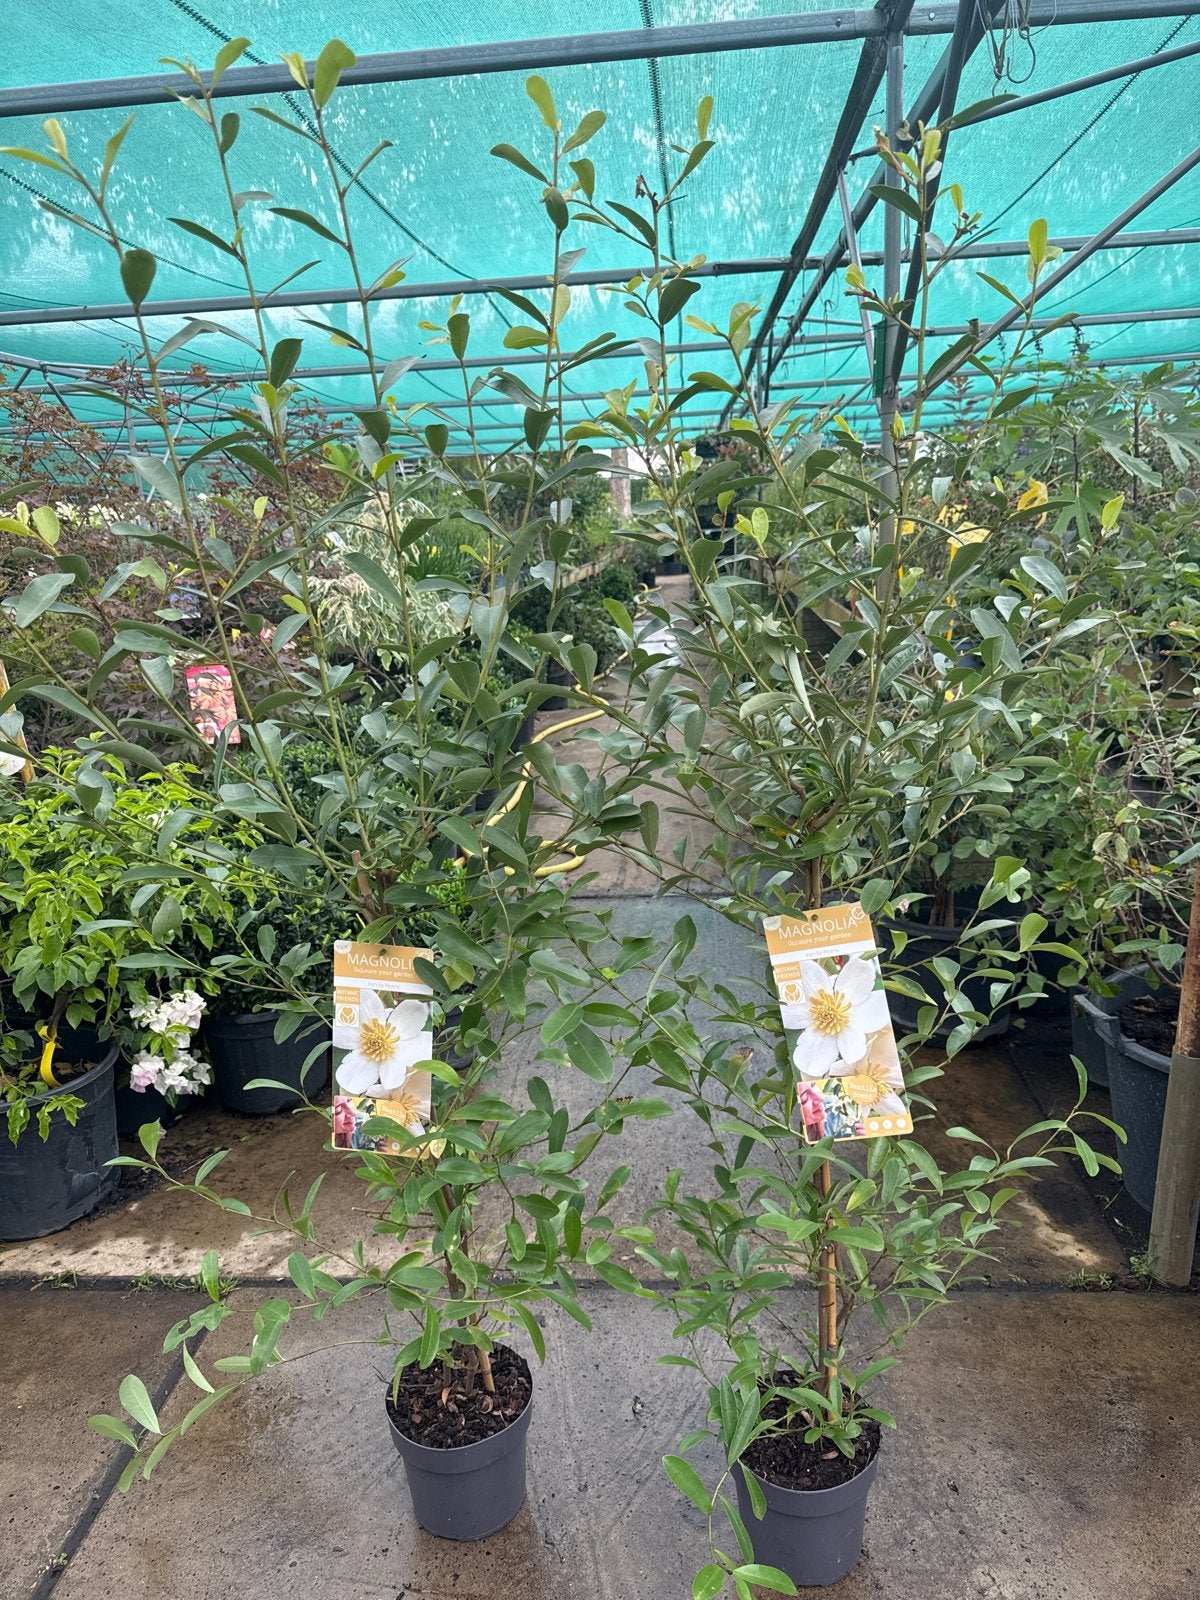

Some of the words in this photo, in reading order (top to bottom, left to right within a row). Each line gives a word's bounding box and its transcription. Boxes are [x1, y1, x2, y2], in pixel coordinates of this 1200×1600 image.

[778, 916, 858, 940] MAGNOLIA
[814, 935, 830, 944] your
[830, 931, 852, 941] garden
[378, 969, 393, 977] your
[393, 971, 414, 979] garden
[775, 965, 799, 973] BOTANIC
[777, 971, 801, 979] FRIENDS
